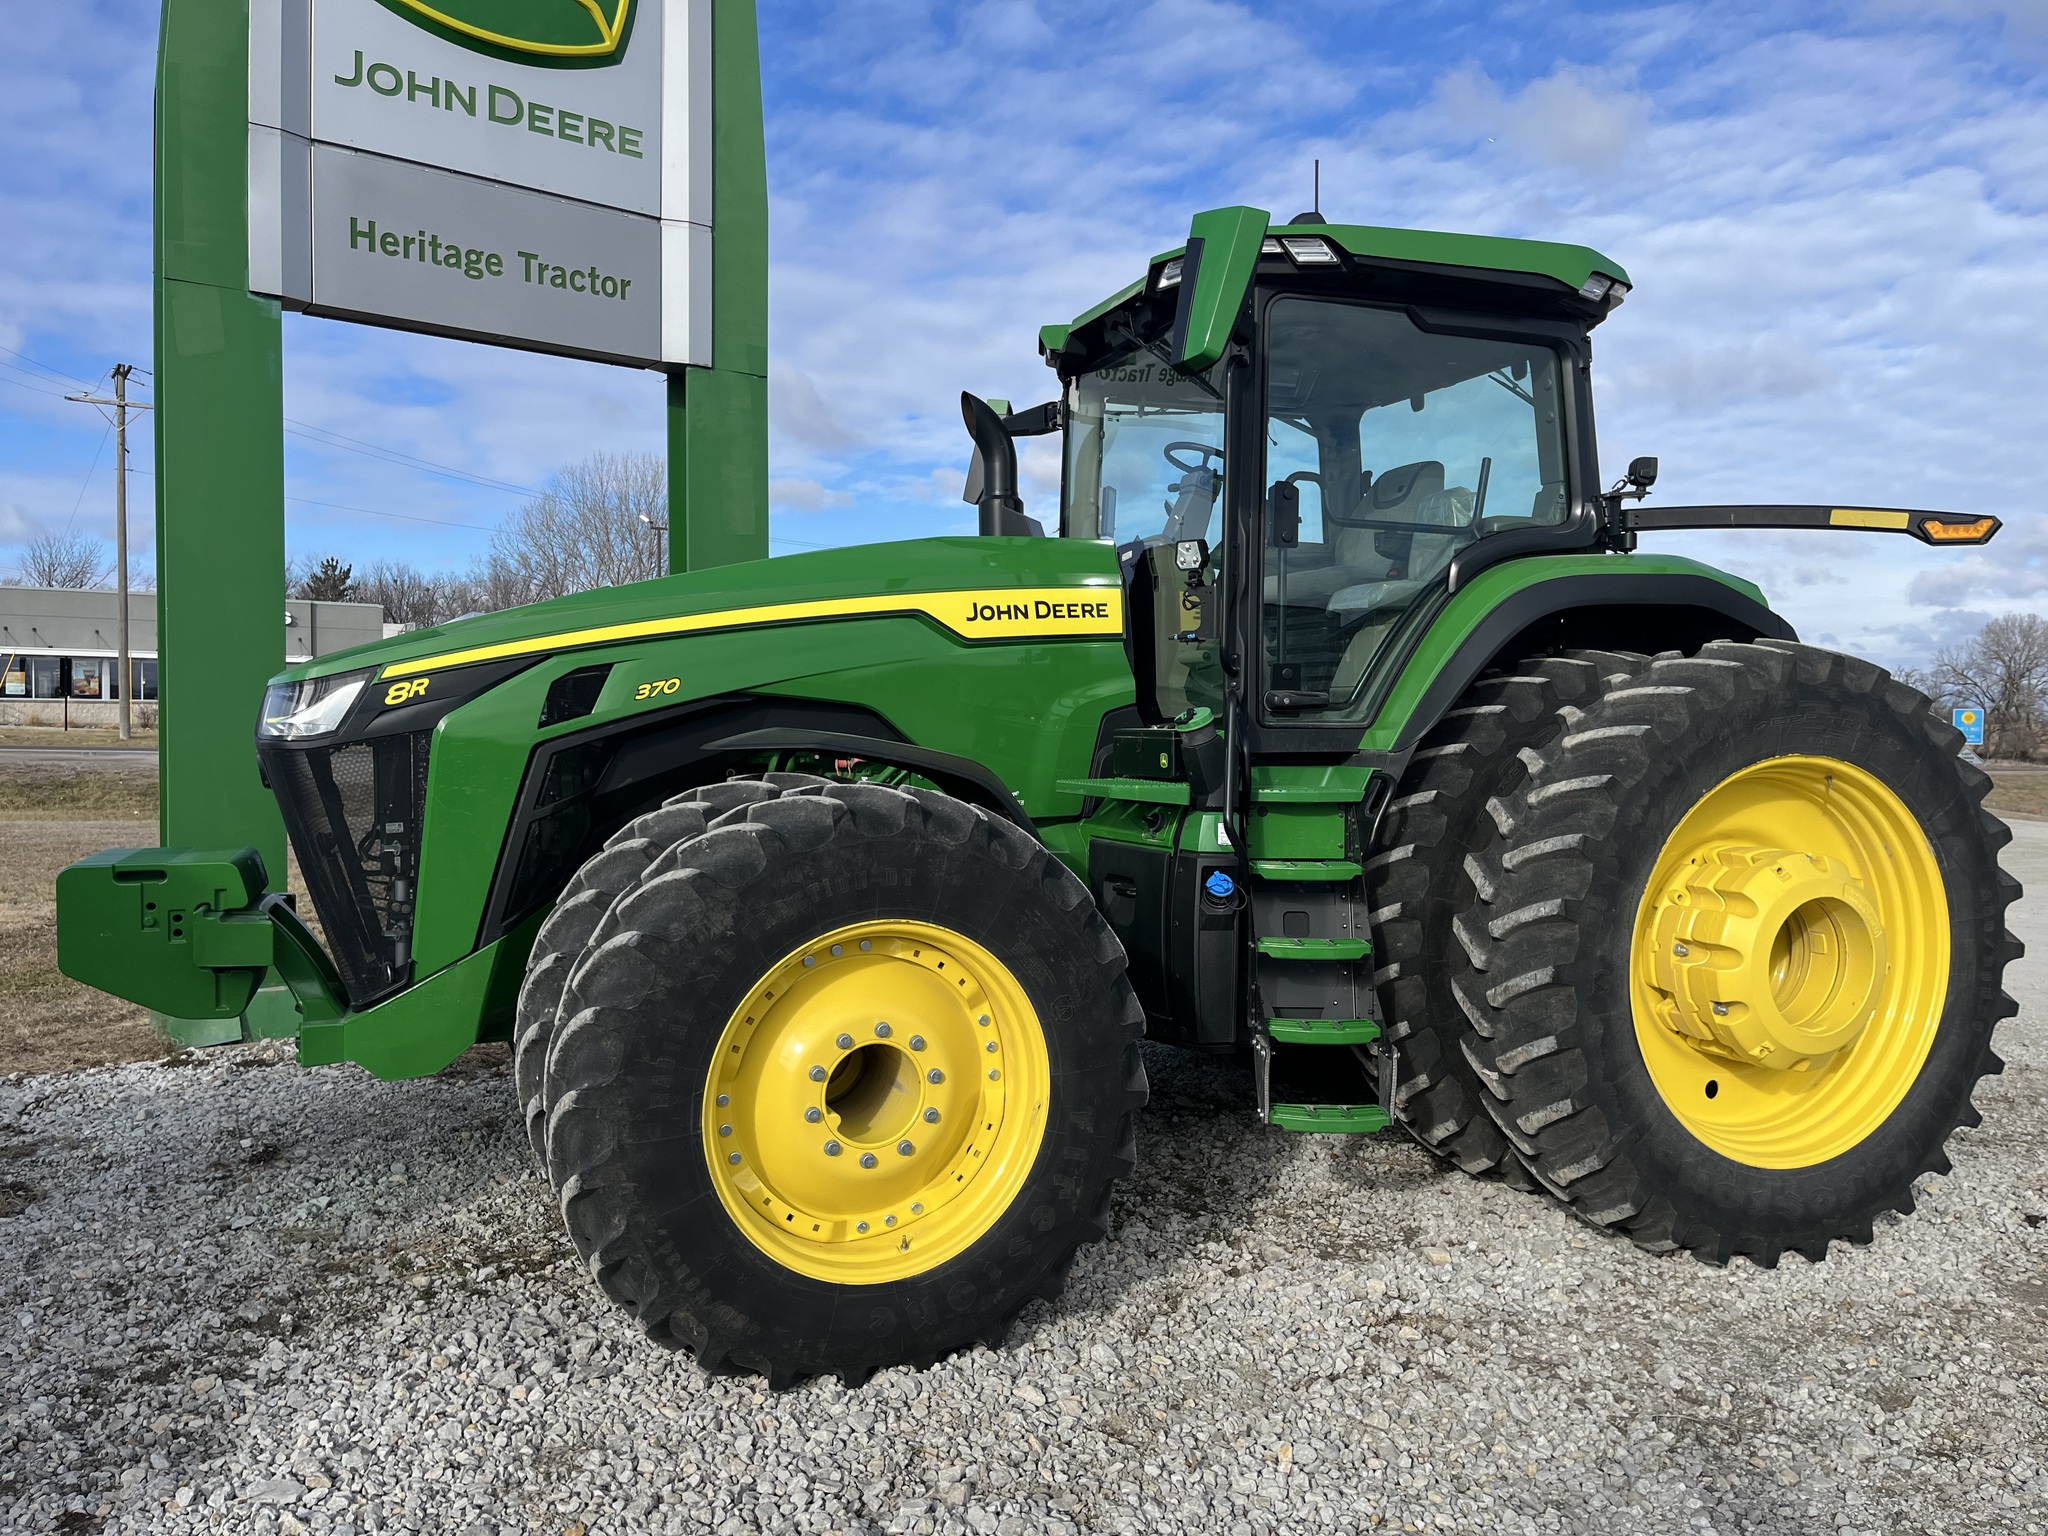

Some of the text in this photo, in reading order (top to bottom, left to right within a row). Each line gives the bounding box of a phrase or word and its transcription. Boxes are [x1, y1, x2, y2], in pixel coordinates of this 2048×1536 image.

[335, 50, 644, 159] JOHN DEERE
[350, 217, 632, 300] Heritage Tractor
[966, 600, 1109, 622] JOHN DEERE
[384, 677, 430, 706] 8R
[634, 677, 681, 700] 370
